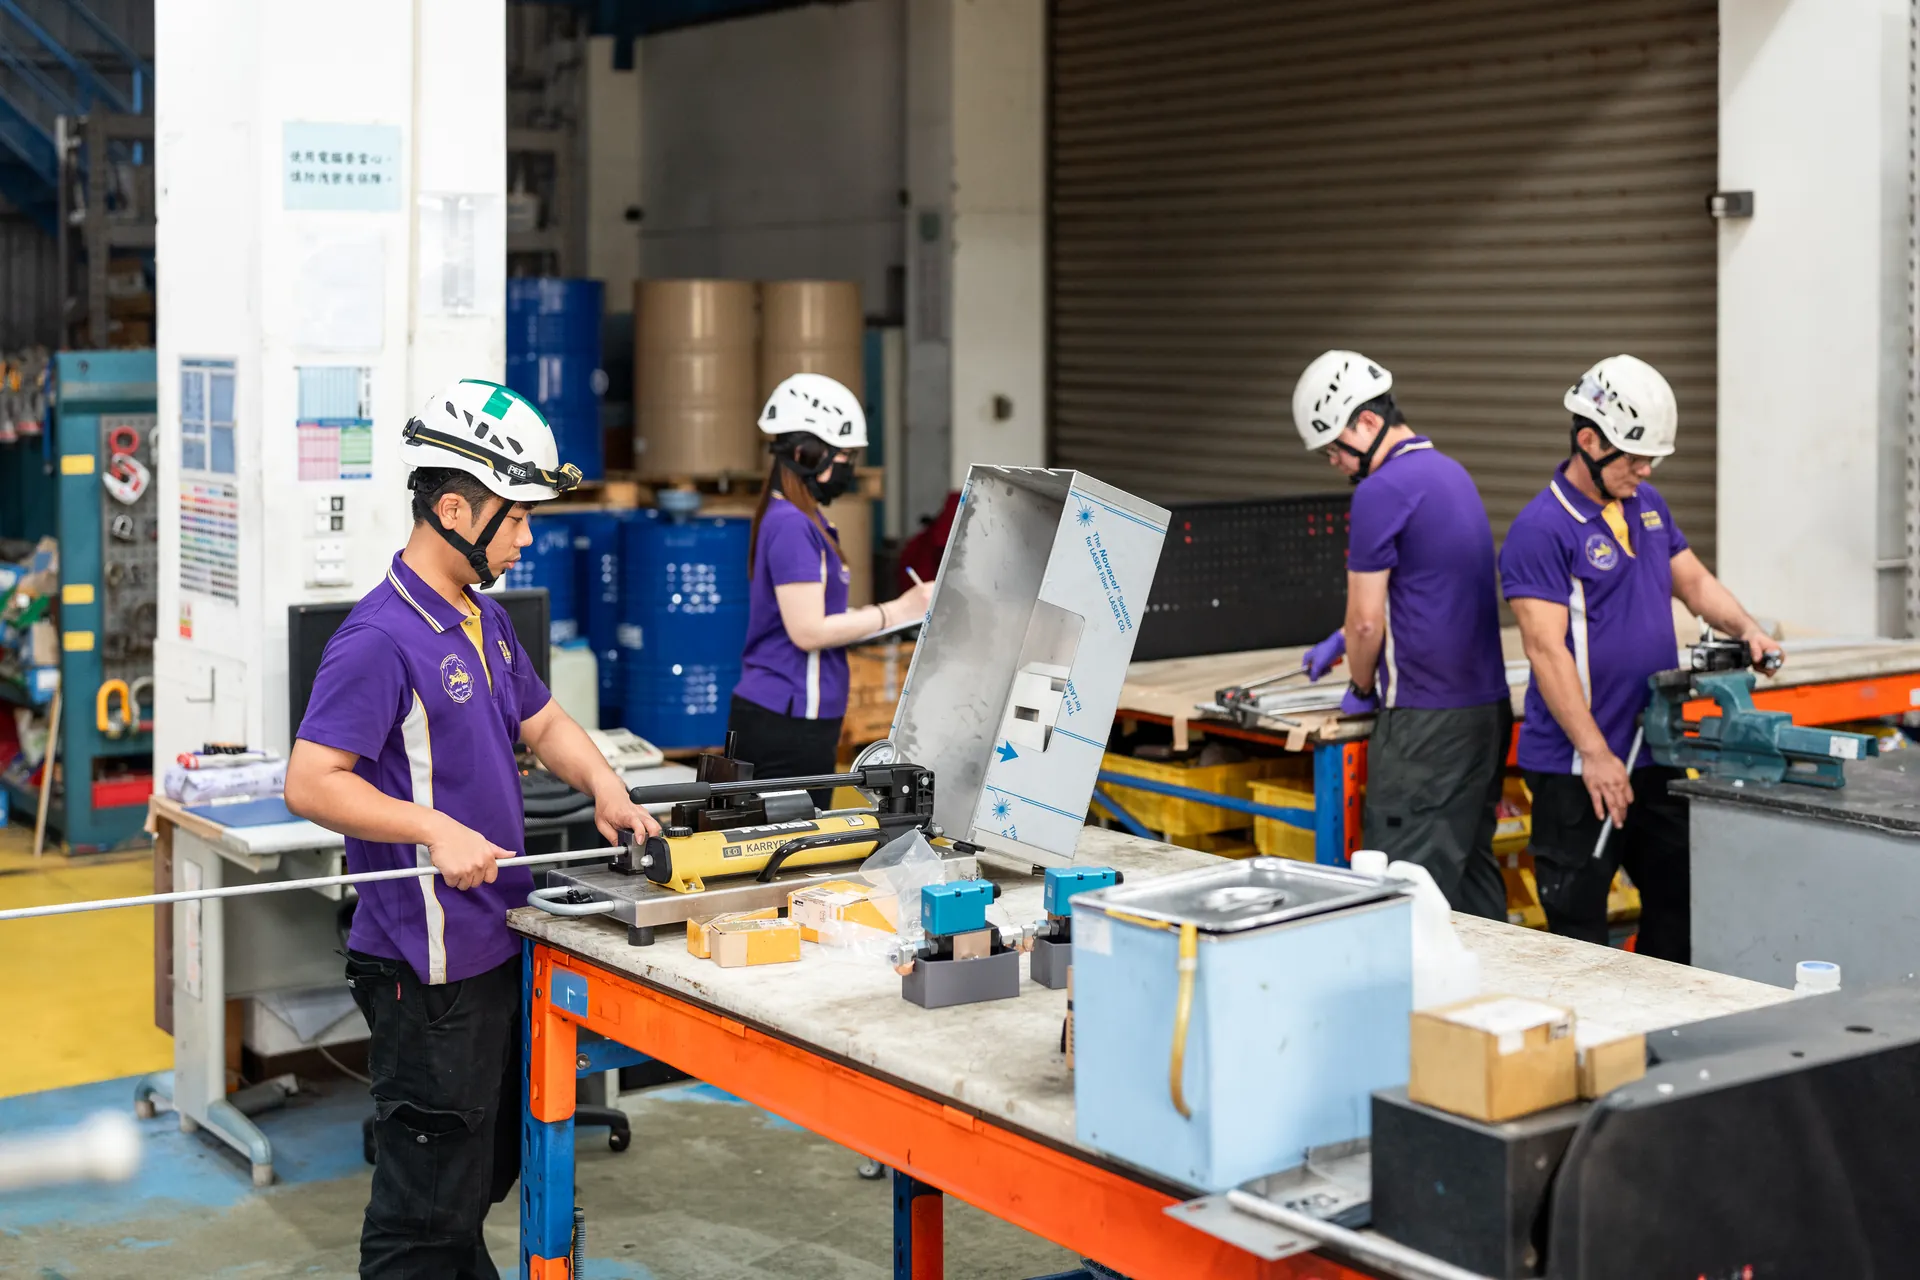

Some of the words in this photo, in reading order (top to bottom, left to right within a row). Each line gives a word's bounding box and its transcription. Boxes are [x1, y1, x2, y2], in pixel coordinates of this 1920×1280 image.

[508, 465, 526, 476] PETZ
[1085, 536, 1093, 548] for
[1089, 547, 1103, 572] LASER
[1099, 571, 1109, 591] Fiber
[1108, 595, 1121, 620] LASER
[1092, 531, 1102, 549] The
[1116, 595, 1133, 630] Solution
[1066, 700, 1074, 716] The
[1074, 700, 1082, 712] for
[1009, 824, 1017, 840] The
